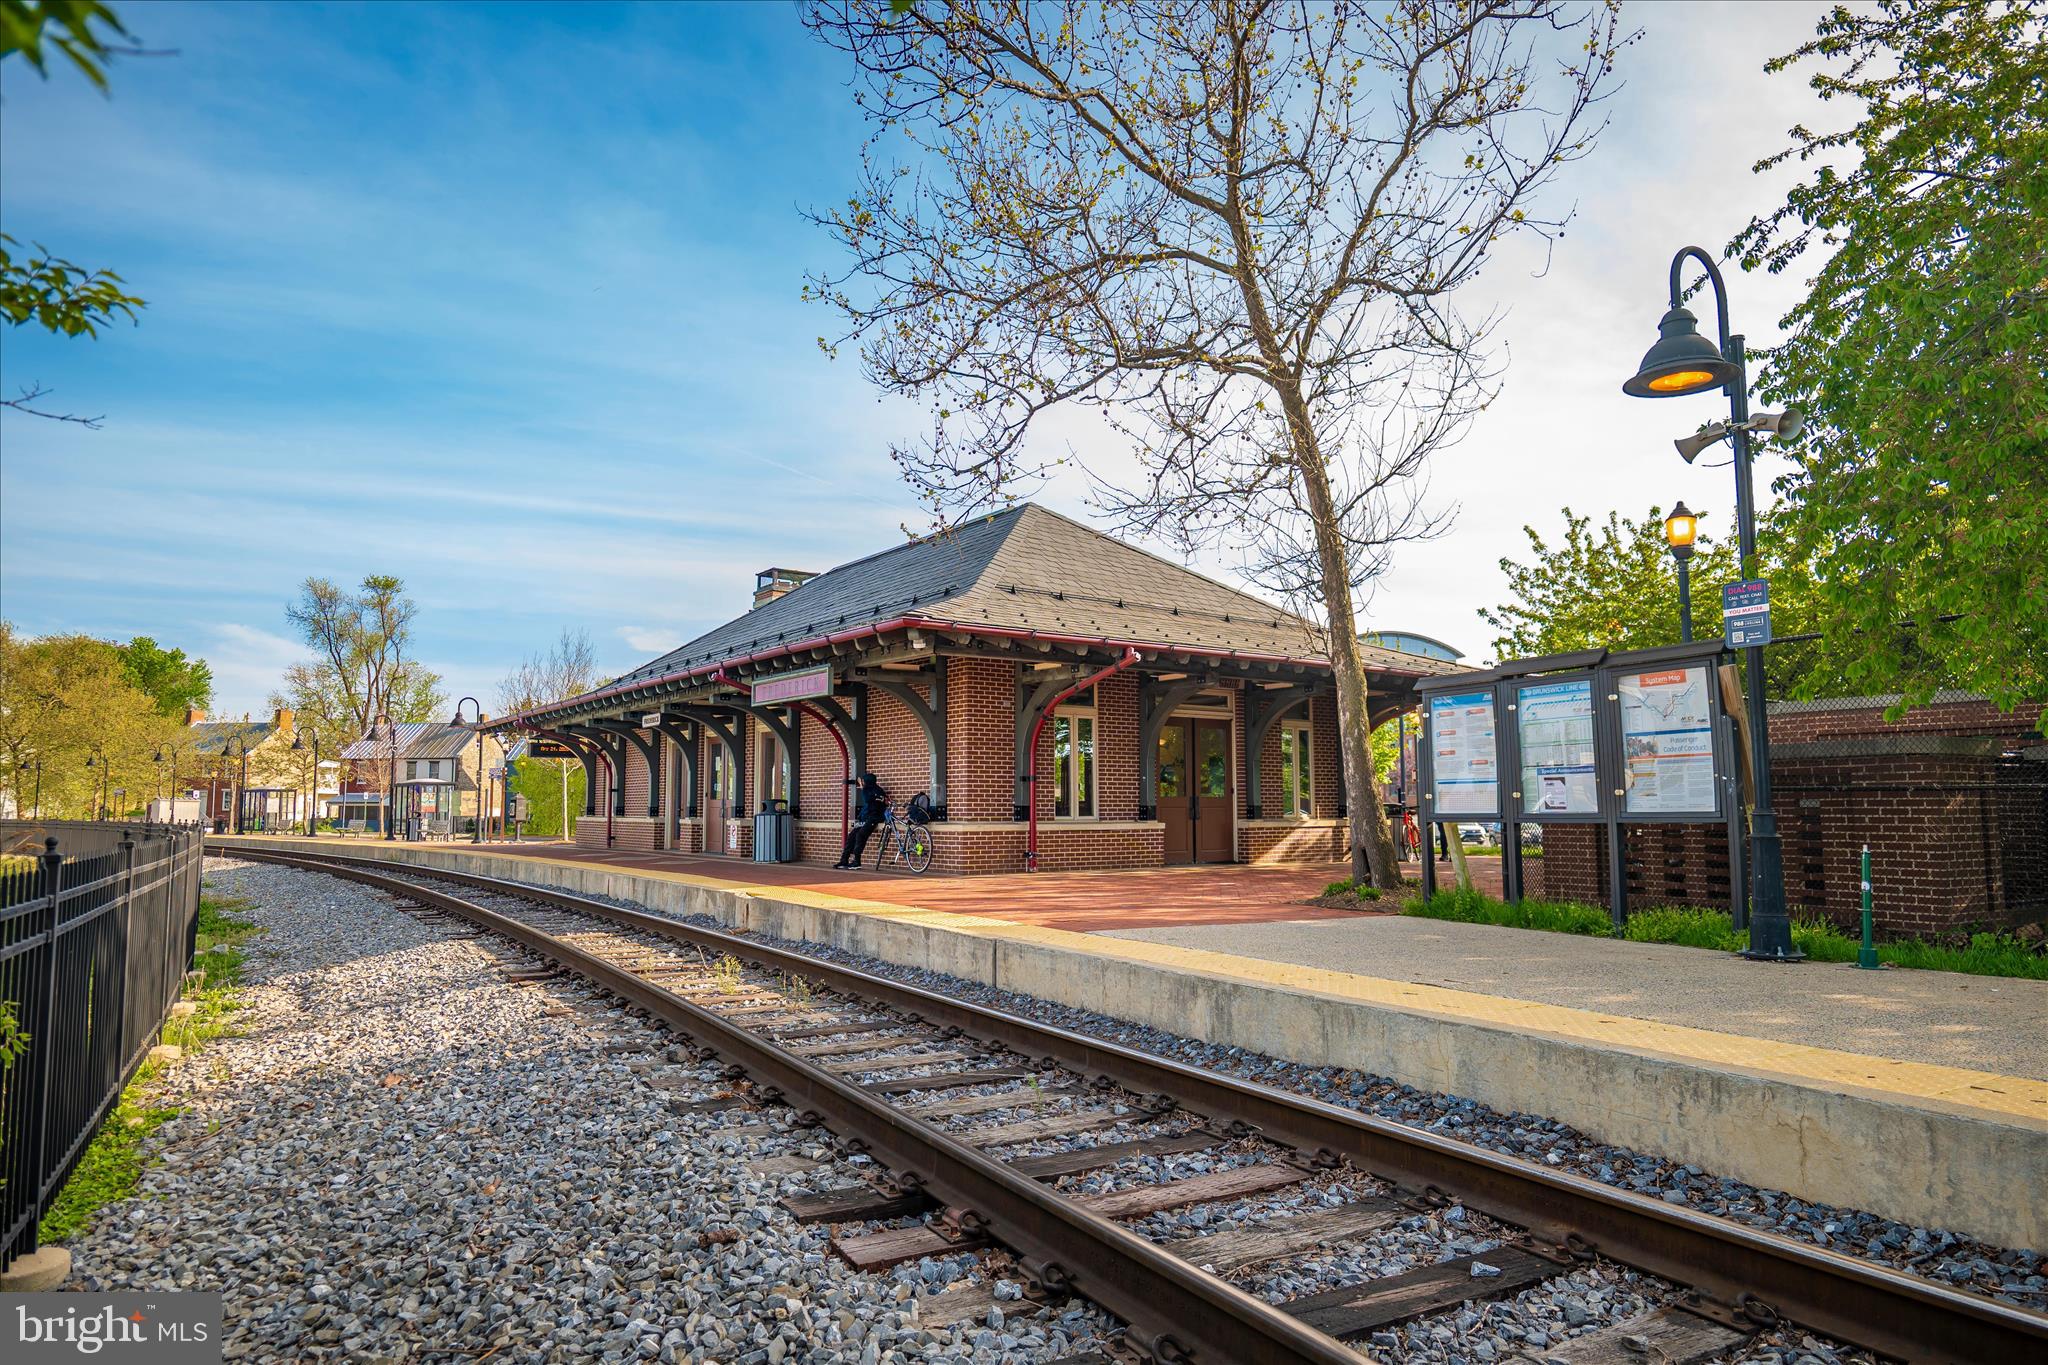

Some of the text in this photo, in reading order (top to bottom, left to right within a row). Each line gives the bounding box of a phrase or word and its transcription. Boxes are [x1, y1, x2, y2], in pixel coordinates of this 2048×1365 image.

[1728, 584, 1761, 595] DIAL 988
[1646, 676, 1668, 685] System
[1532, 686, 1565, 695] BRUNSWICK
[1565, 684, 1579, 692] LINE
